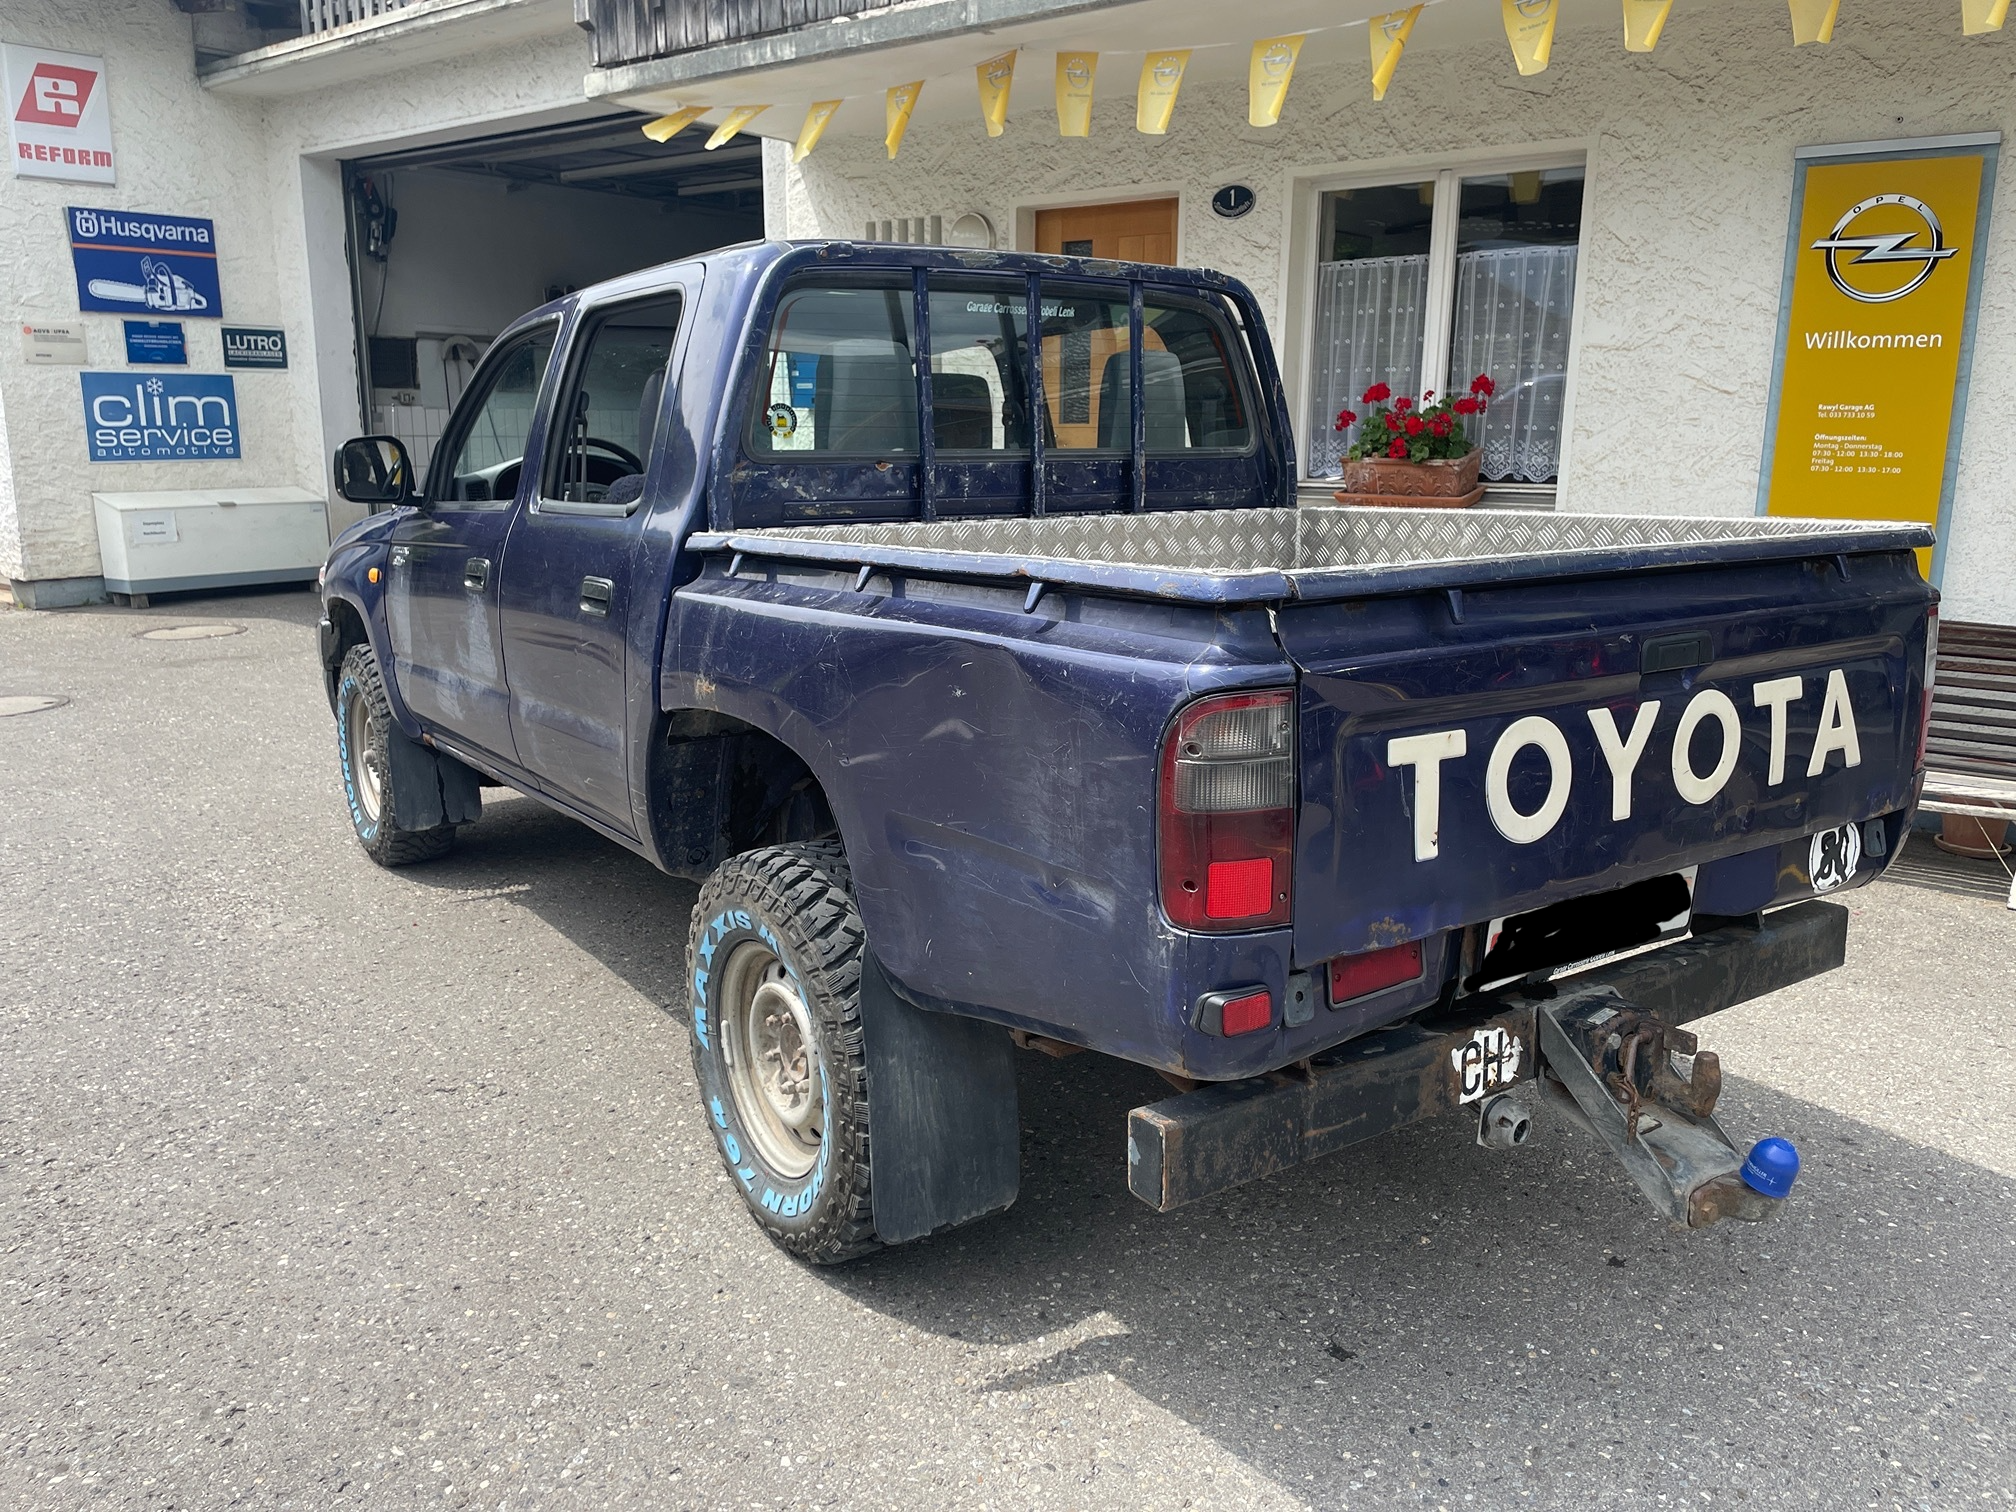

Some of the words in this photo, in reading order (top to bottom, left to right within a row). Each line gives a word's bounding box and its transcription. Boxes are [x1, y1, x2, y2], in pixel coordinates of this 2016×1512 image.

[18, 142, 112, 168] REFORM
[1229, 188, 1235, 207] 1
[1852, 195, 1923, 214] OPEL
[100, 215, 209, 243] Husqvarna
[966, 301, 993, 312] Garage
[994, 303, 1027, 315] Carrosse
[226, 334, 282, 351] LUTRO
[1805, 330, 1943, 349] Willkommen
[93, 383, 231, 427] clim
[1818, 403, 1838, 412] Rawyl
[1839, 404, 1863, 412] Garage
[95, 422, 233, 447] service
[97, 446, 234, 456] automotive
[1813, 443, 1839, 451] Montag
[1844, 443, 1883, 451] Donnerstag
[1387, 668, 1862, 863] TOYOTA
[694, 910, 753, 1052] MAXXIS
